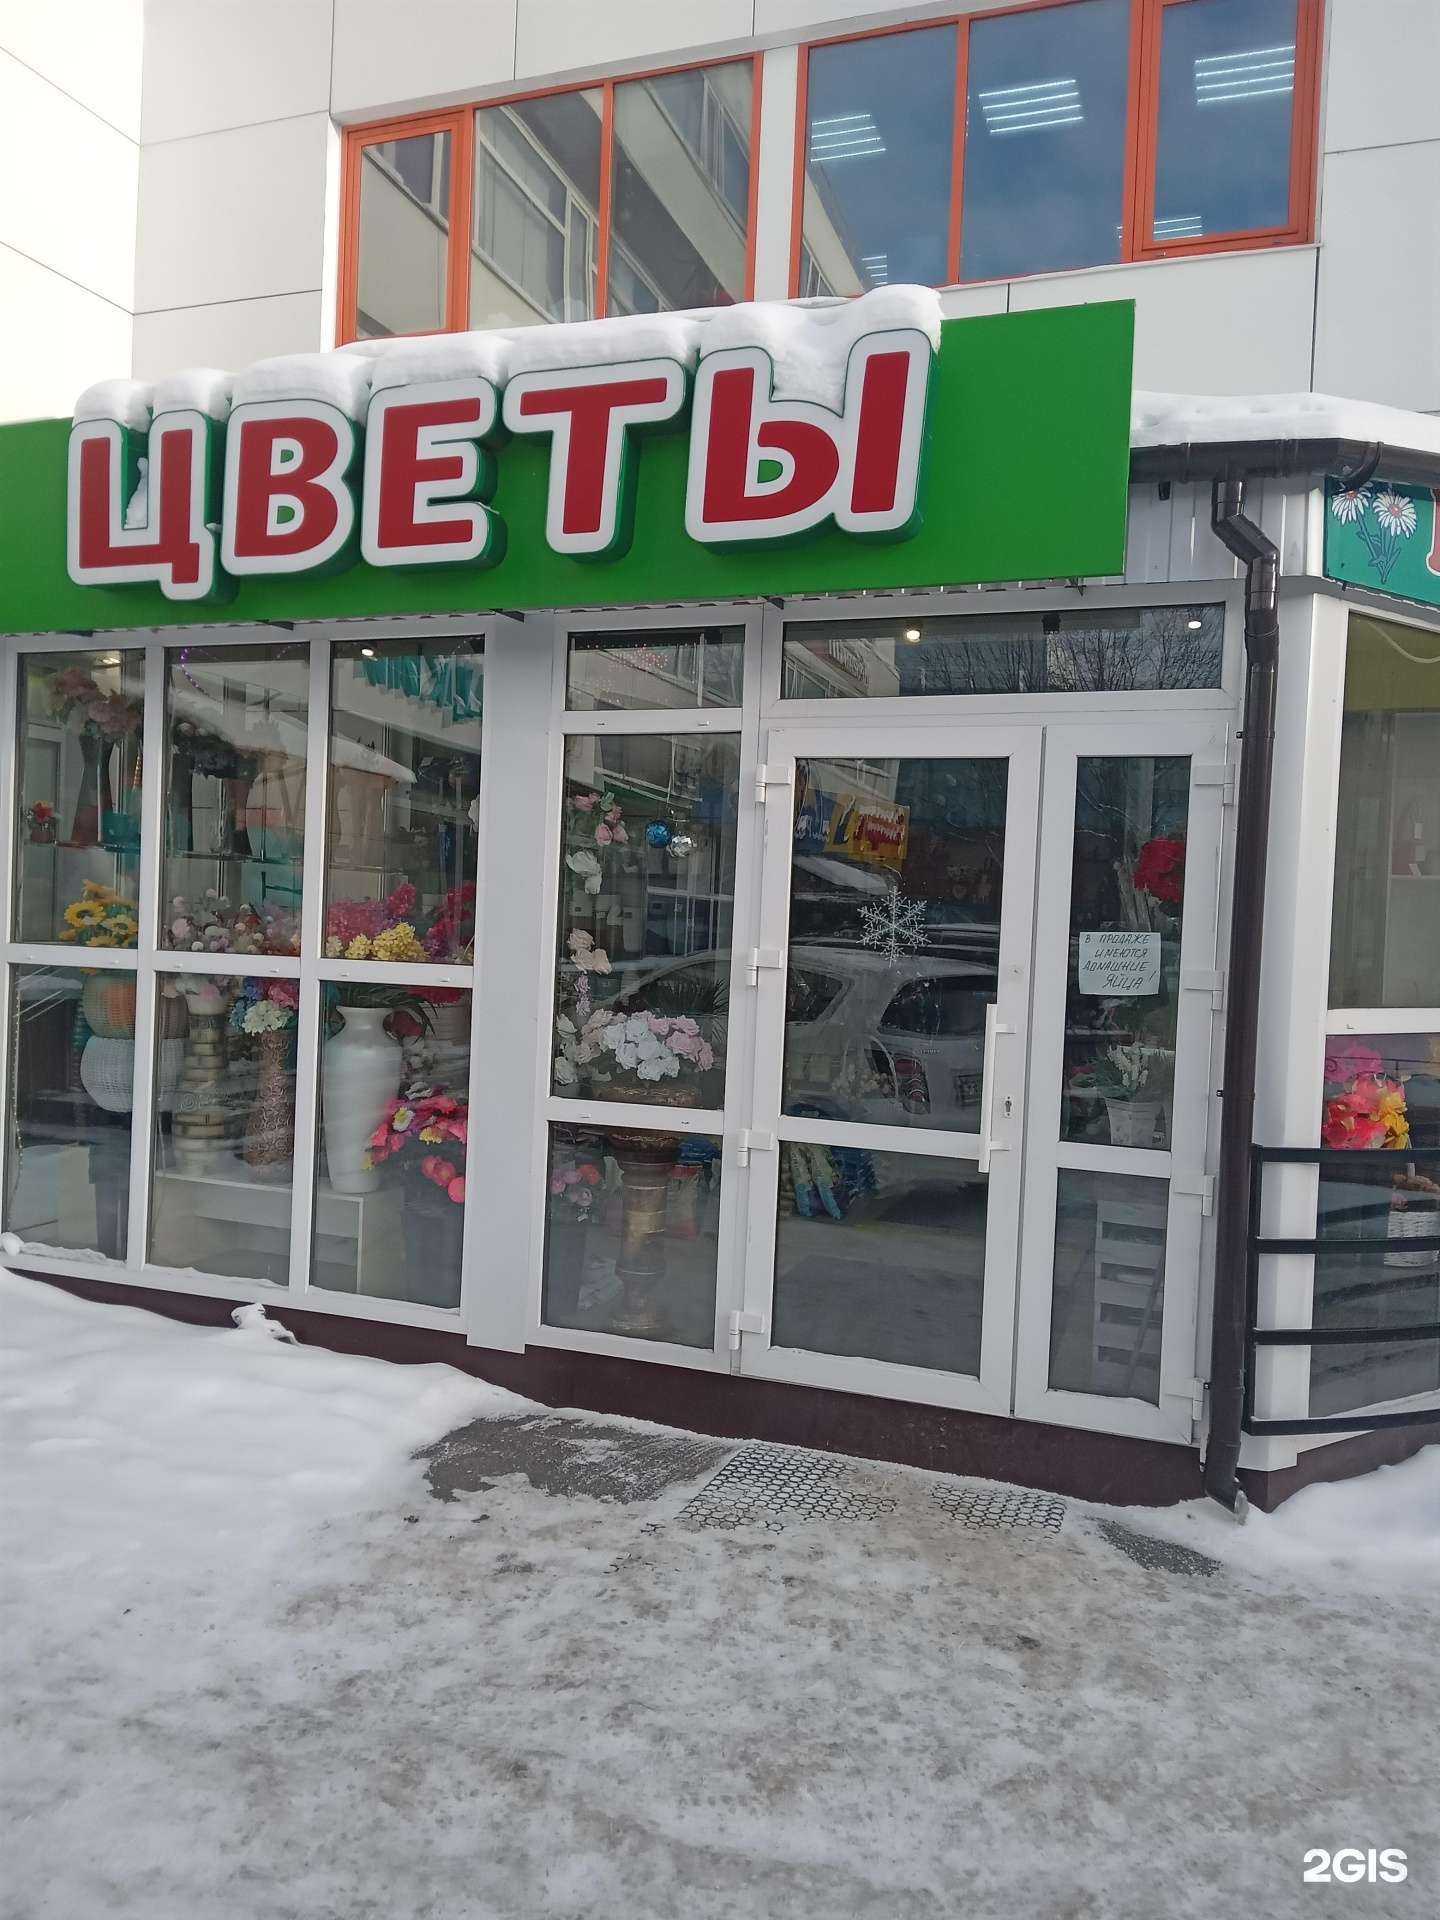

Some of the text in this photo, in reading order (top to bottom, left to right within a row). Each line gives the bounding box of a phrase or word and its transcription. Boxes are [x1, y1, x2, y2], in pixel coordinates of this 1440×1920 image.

[71, 335, 924, 596] ЦВЕТЫ
[1084, 933, 1151, 944] В ПРОДАЖЕ
[1094, 946, 1148, 959] ИМЕЮТСЯ
[1082, 960, 1152, 972] ДОМАШНИЕ
